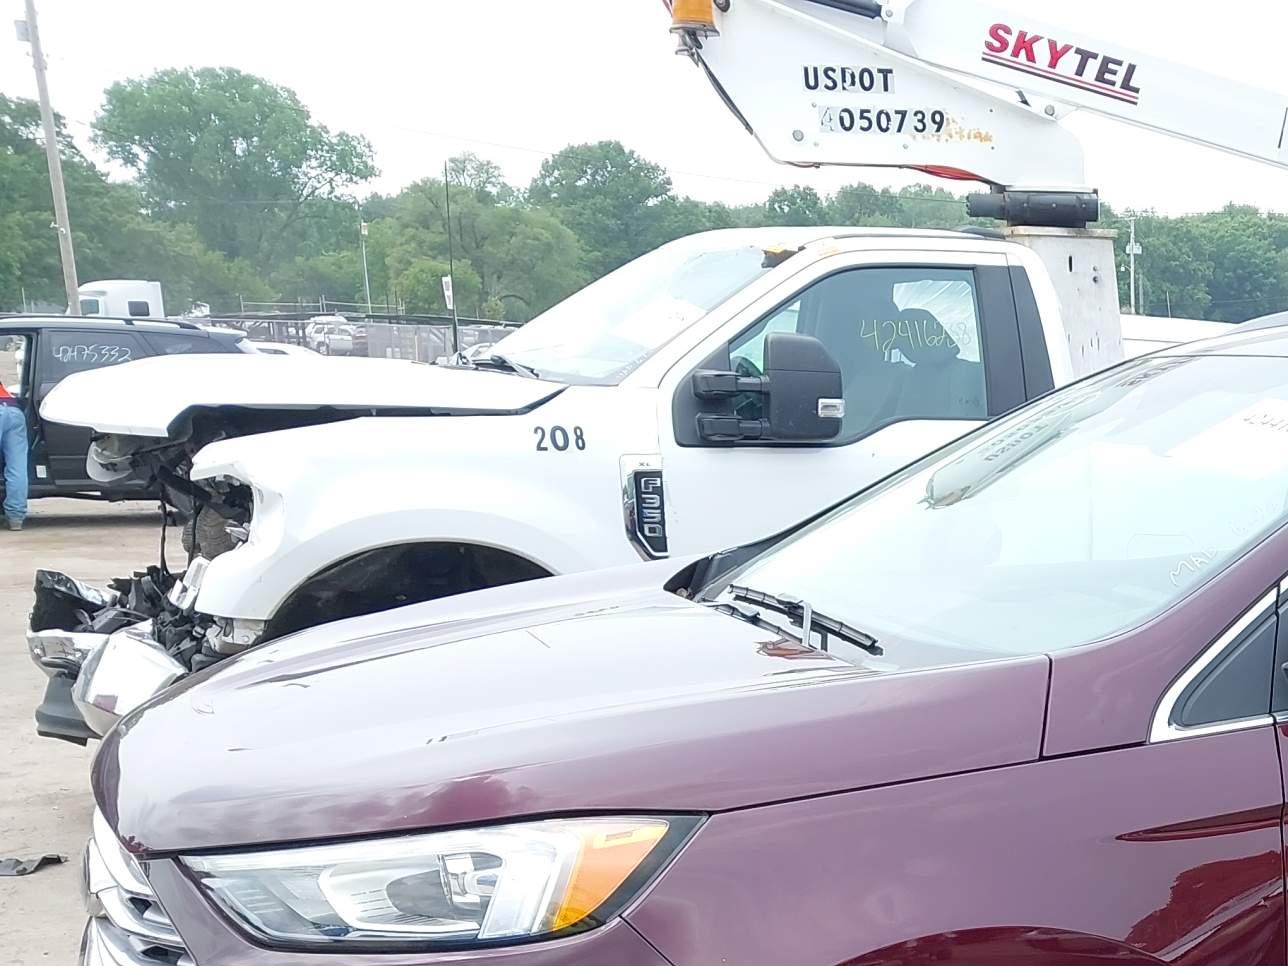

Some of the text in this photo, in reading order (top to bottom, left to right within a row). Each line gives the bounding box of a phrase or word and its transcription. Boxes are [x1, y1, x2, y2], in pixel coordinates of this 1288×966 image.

[985, 23, 1140, 94] SKYTEL
[803, 66, 894, 92] USDOT
[535, 426, 587, 452] 208
